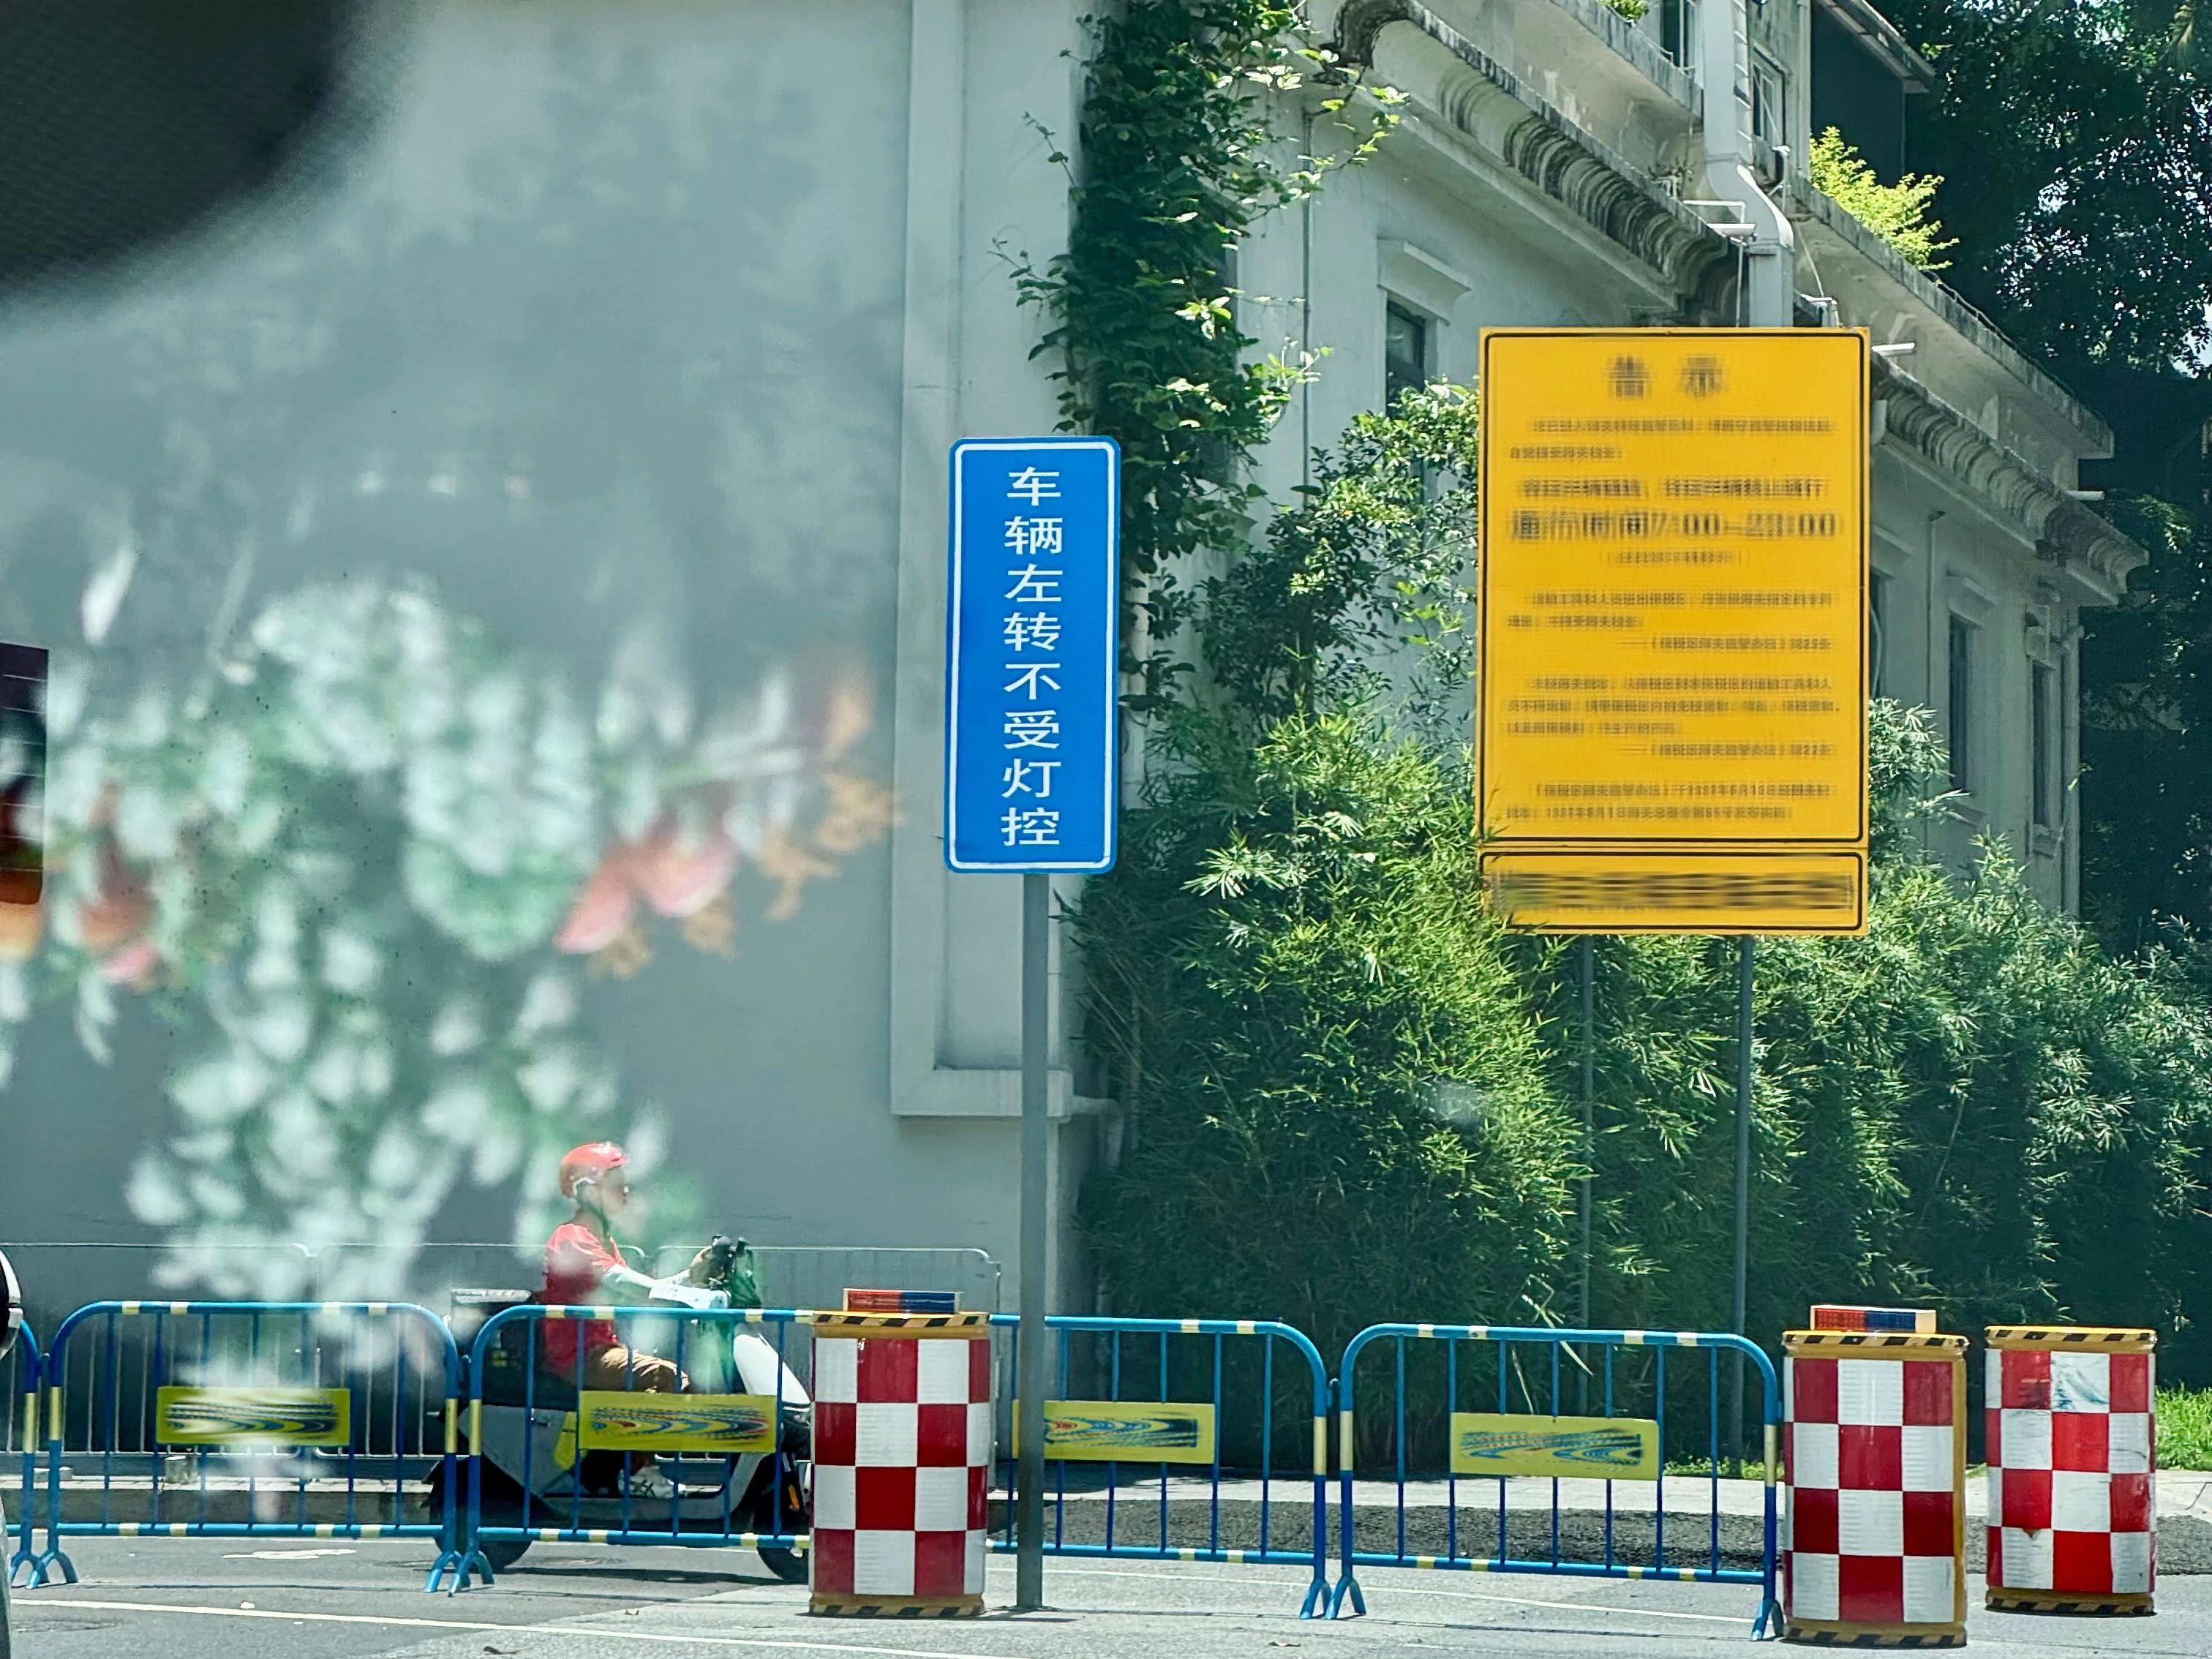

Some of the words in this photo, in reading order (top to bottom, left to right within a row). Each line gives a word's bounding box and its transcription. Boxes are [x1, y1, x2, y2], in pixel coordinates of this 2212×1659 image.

[1000, 466, 1064, 847] 车辆左转不受灯控
